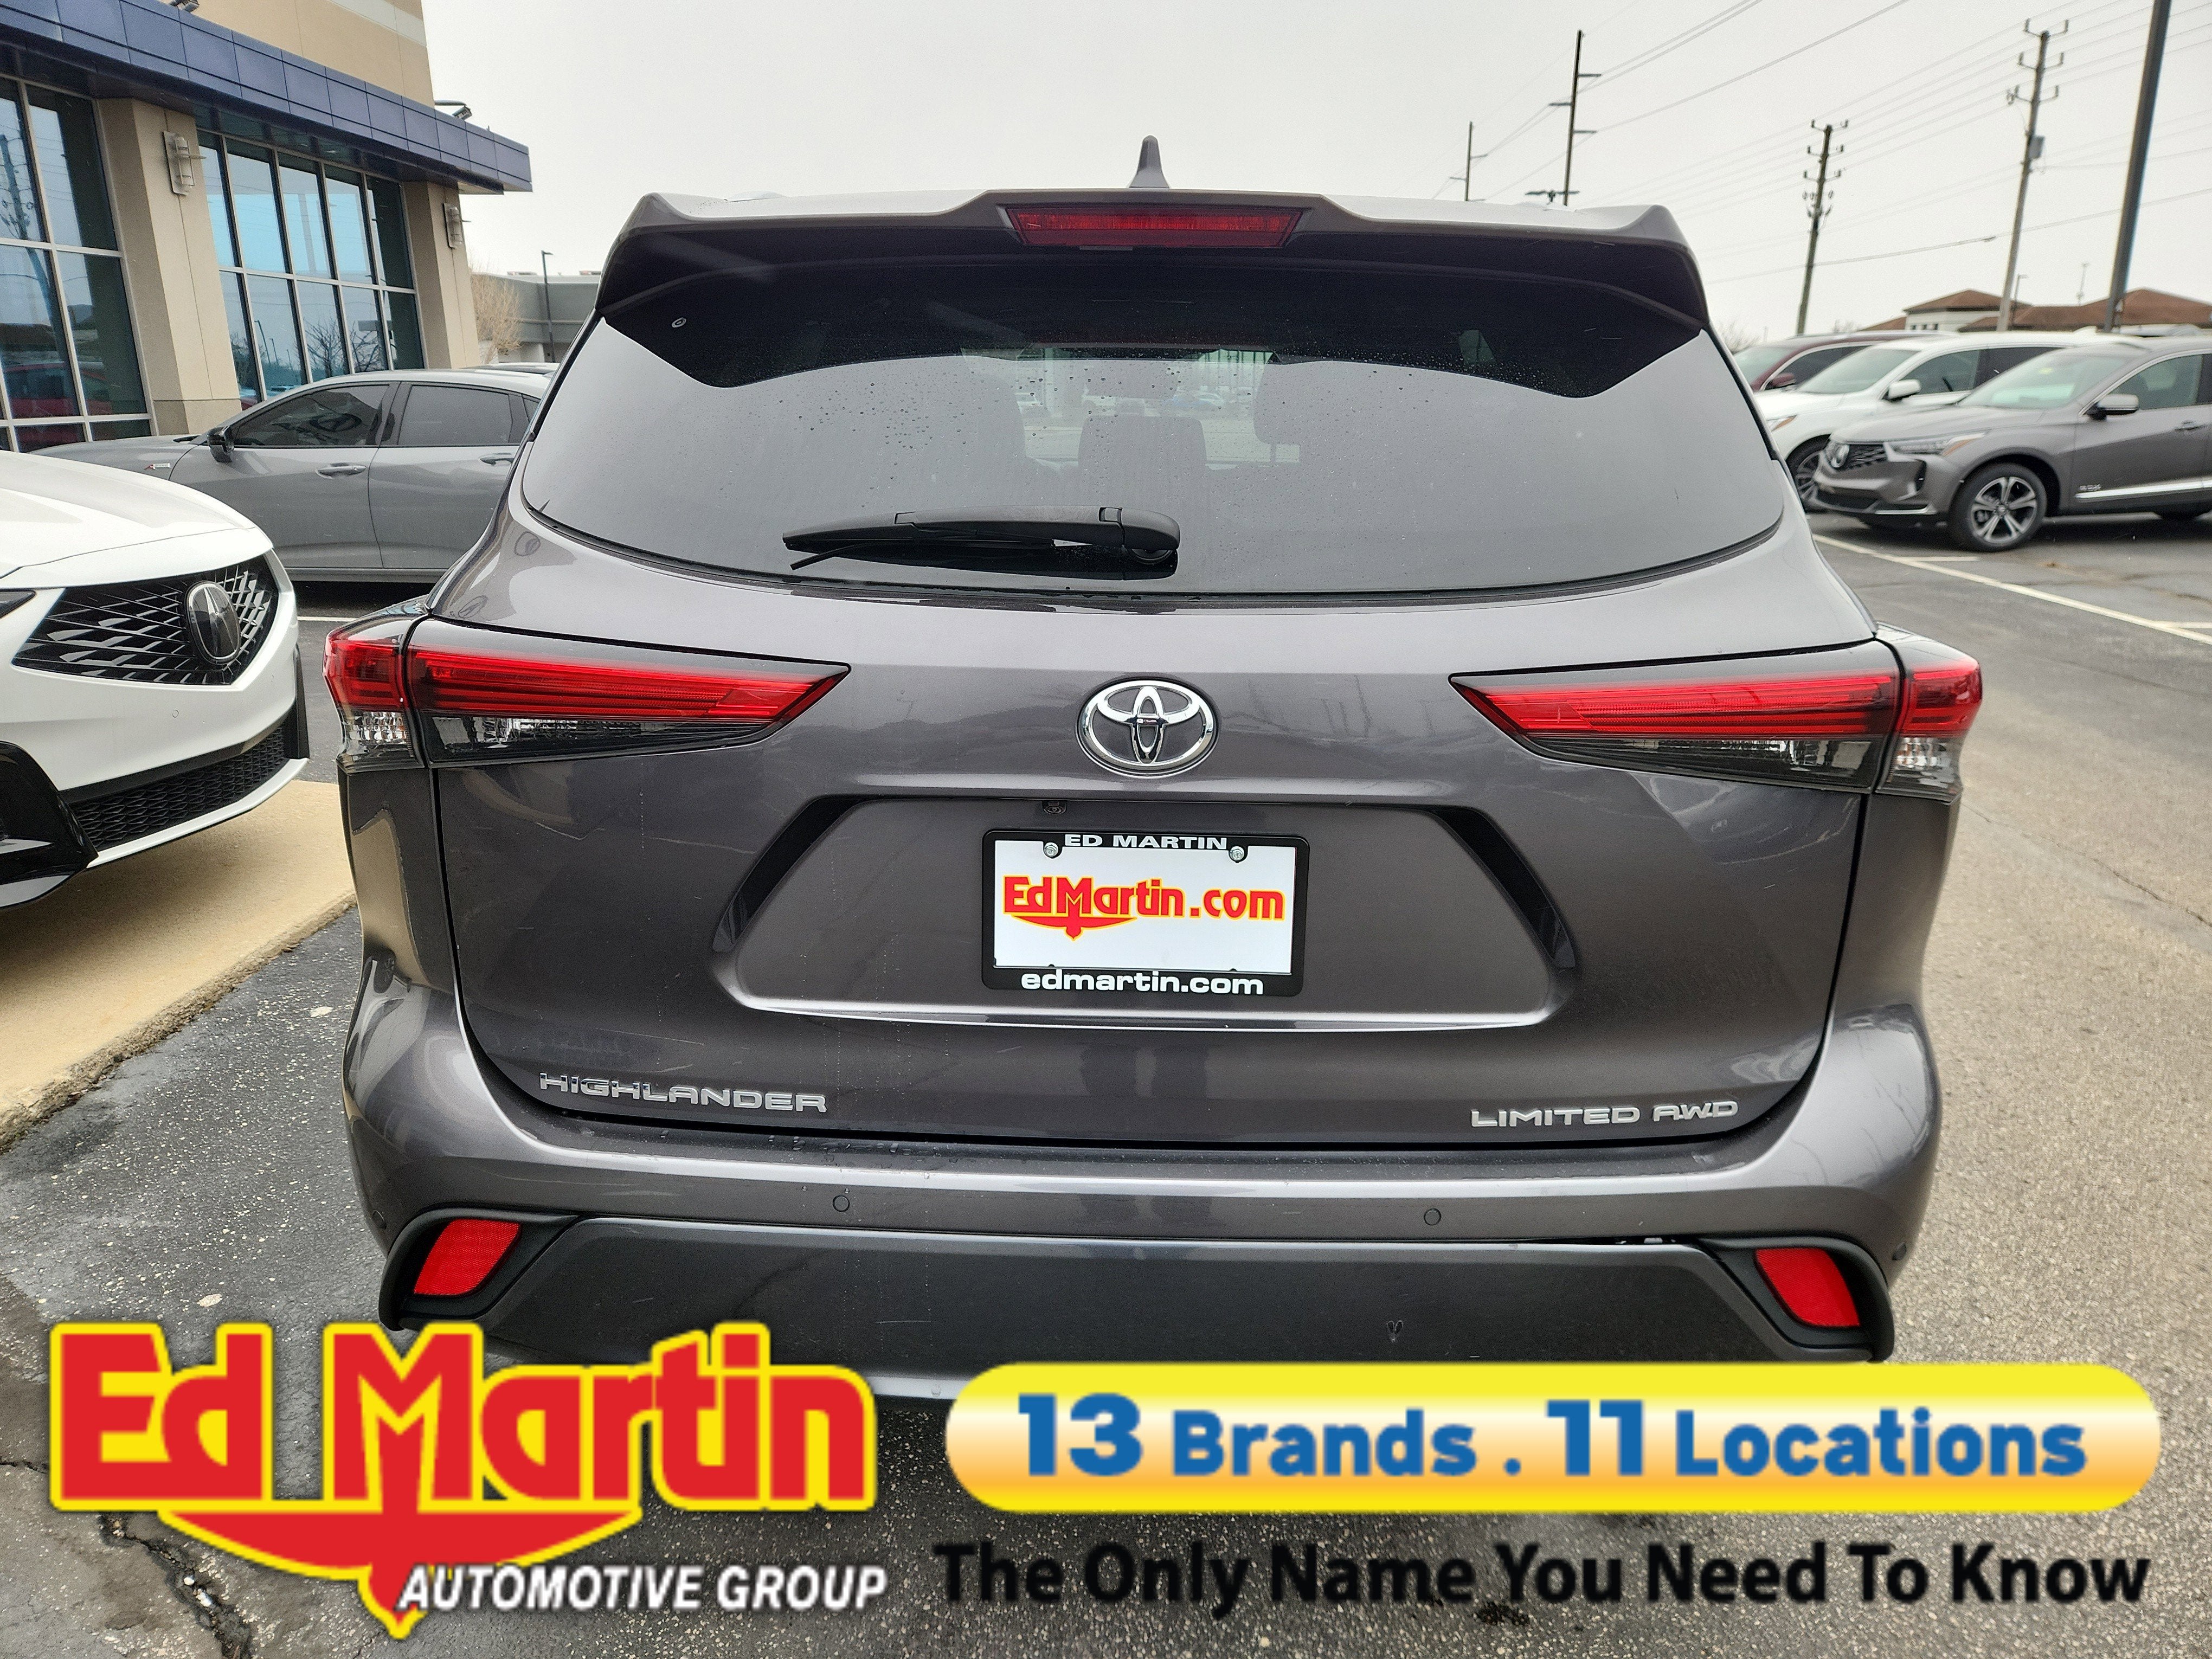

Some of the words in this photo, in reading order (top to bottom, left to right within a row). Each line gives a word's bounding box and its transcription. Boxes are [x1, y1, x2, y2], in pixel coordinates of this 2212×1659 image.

[1064, 835, 1103, 847] ED
[1113, 835, 1227, 850] MARTIN
[1003, 875, 1285, 921] EdMartin.com
[1021, 969, 1264, 995] edmartin.com
[539, 1072, 827, 1113] HIGHLANDER
[1471, 1107, 1641, 1127] LIMITED
[1653, 1100, 1739, 1122] AWD
